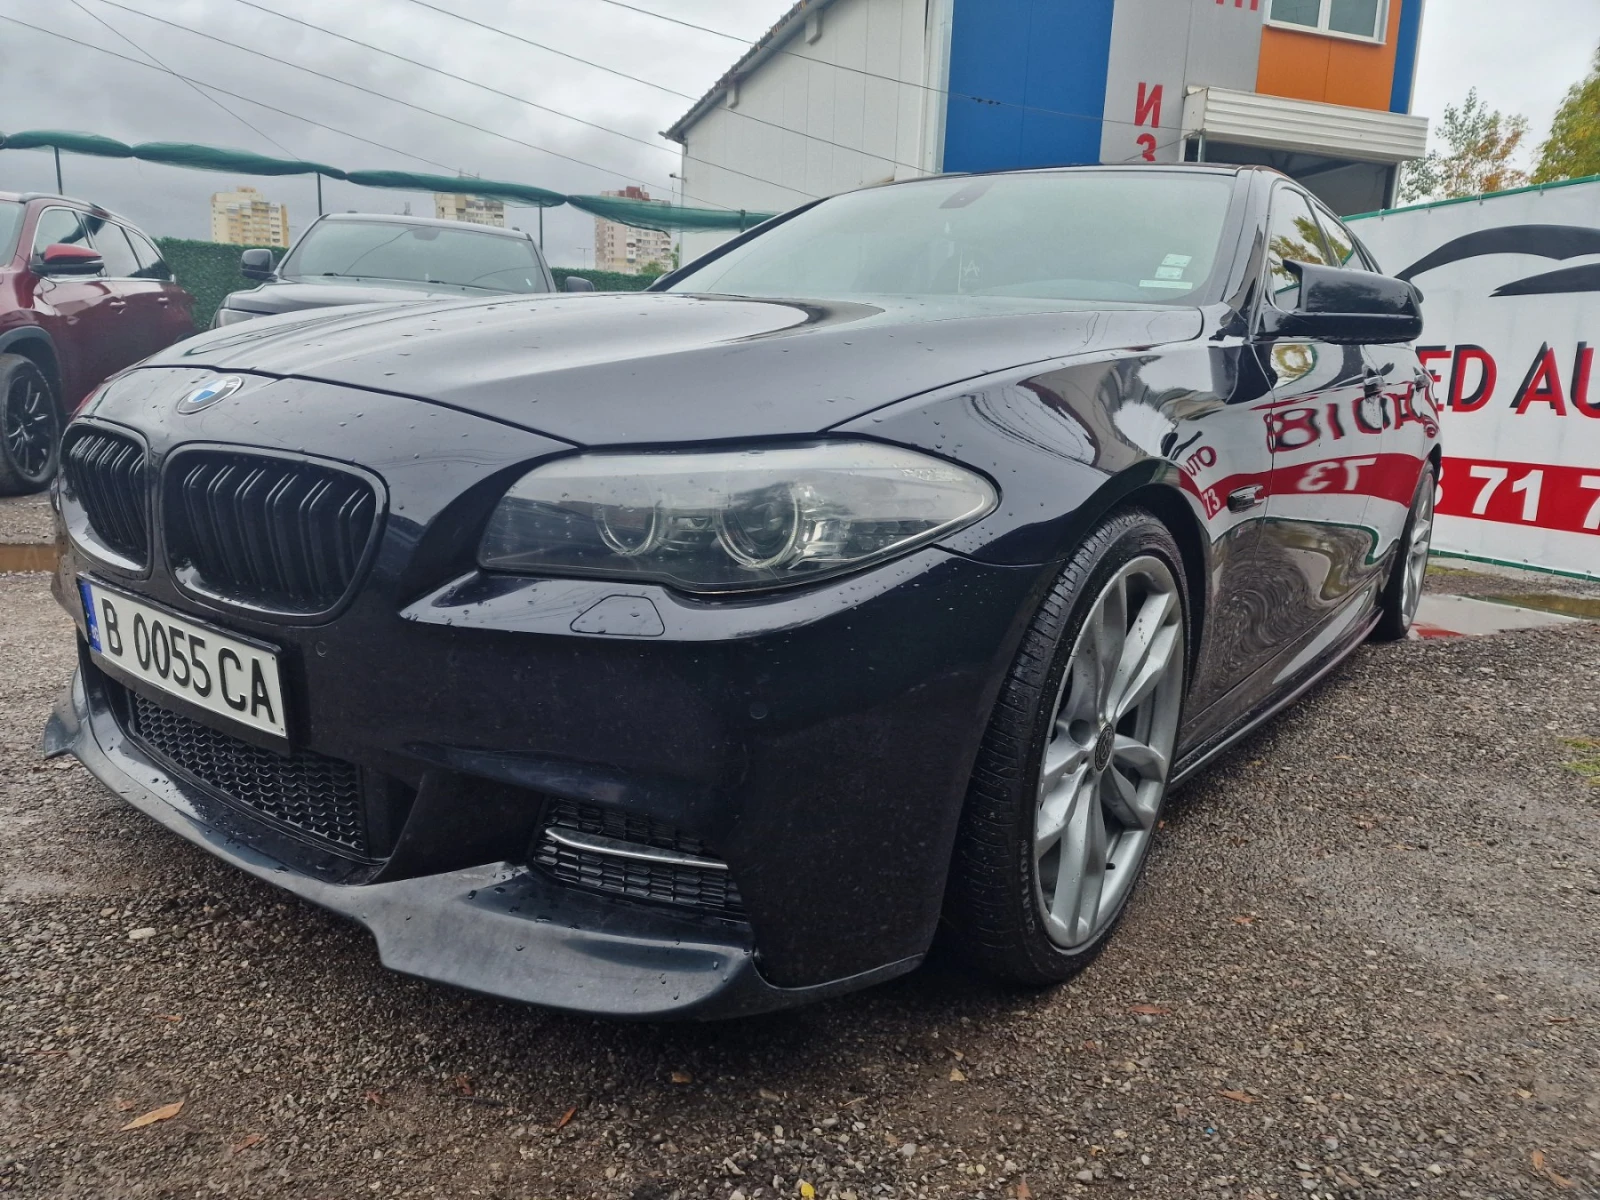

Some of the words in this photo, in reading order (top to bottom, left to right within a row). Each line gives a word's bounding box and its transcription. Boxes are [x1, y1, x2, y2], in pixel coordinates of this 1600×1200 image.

[1470, 465, 1544, 521] 71
[102, 598, 123, 657] B
[134, 612, 212, 698] 0055
[218, 647, 276, 724] CA
